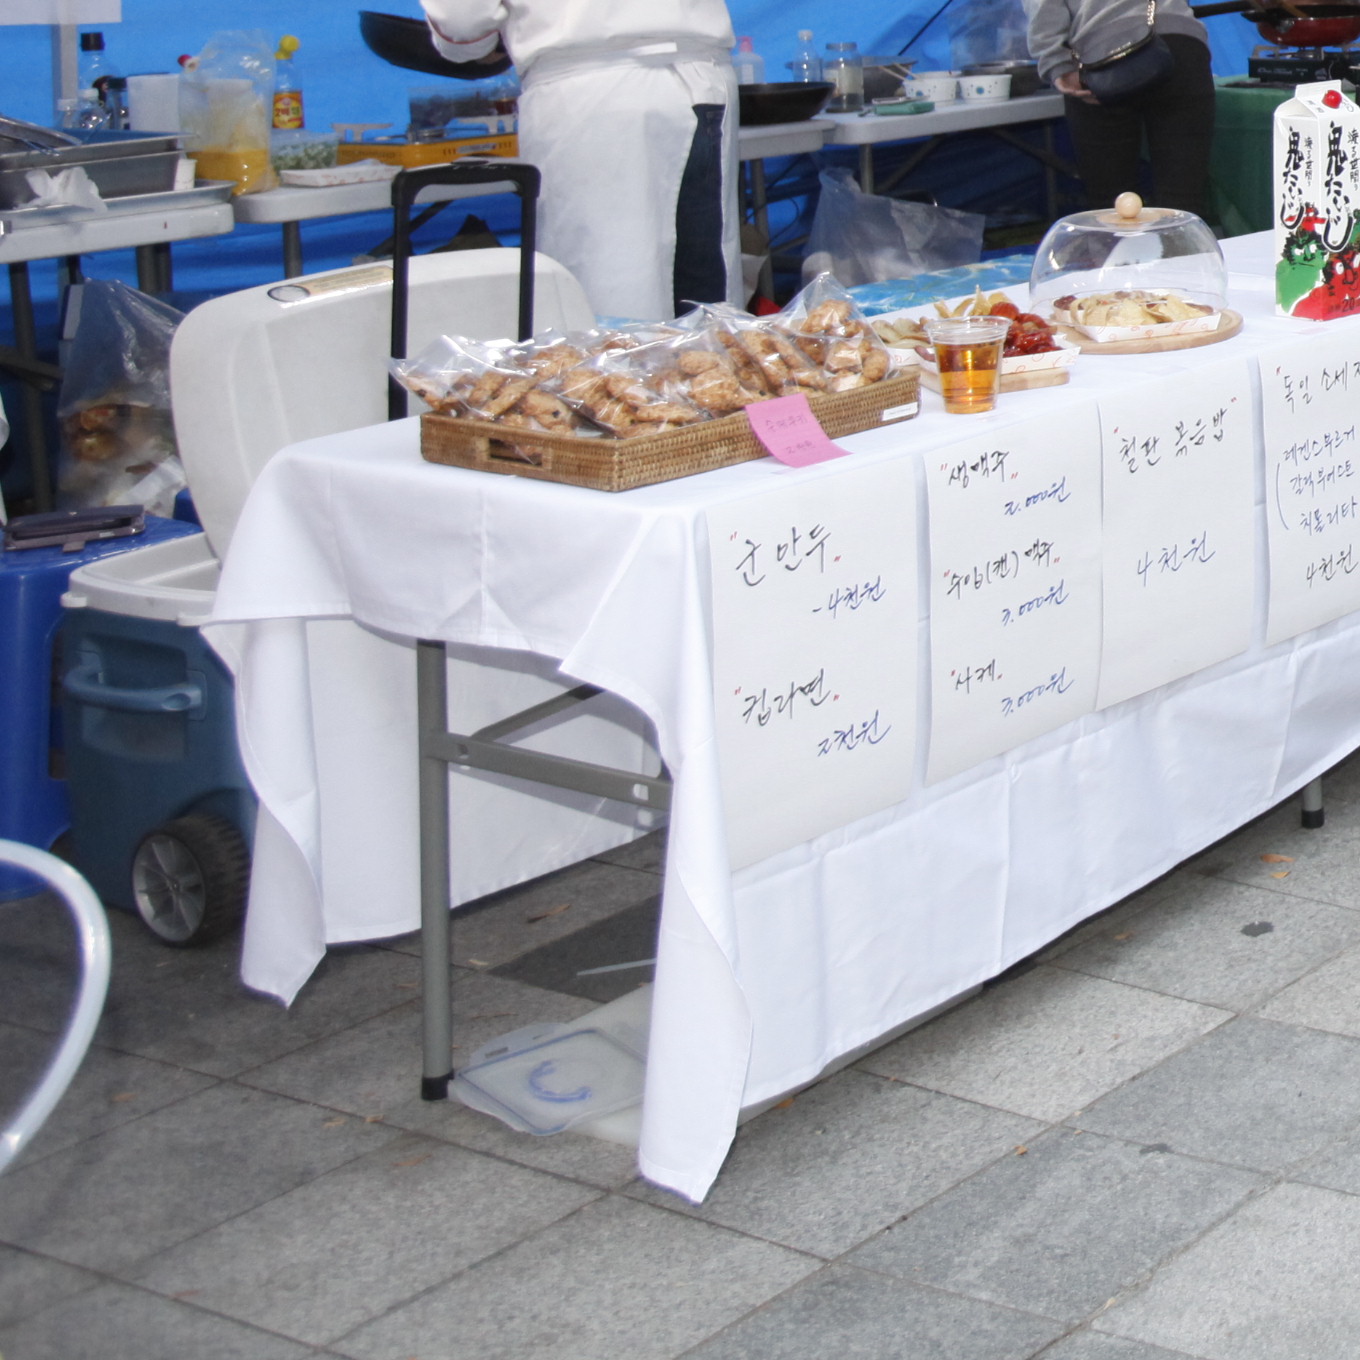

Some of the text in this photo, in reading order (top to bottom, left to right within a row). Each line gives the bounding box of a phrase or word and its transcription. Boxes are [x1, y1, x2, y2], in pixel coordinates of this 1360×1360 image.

[1283, 375, 1312, 414] 독일
[1119, 408, 1228, 473] 철판 볶음밥
[949, 450, 1010, 488] 생맥주
[735, 524, 831, 586] 군만두
[1024, 538, 1055, 568] 맥주
[1137, 531, 1217, 587] 4천원
[1306, 544, 1360, 589] 4천원
[742, 668, 831, 727] 컵라면
[954, 659, 996, 694] 사케
[817, 710, 892, 757] 2천원
